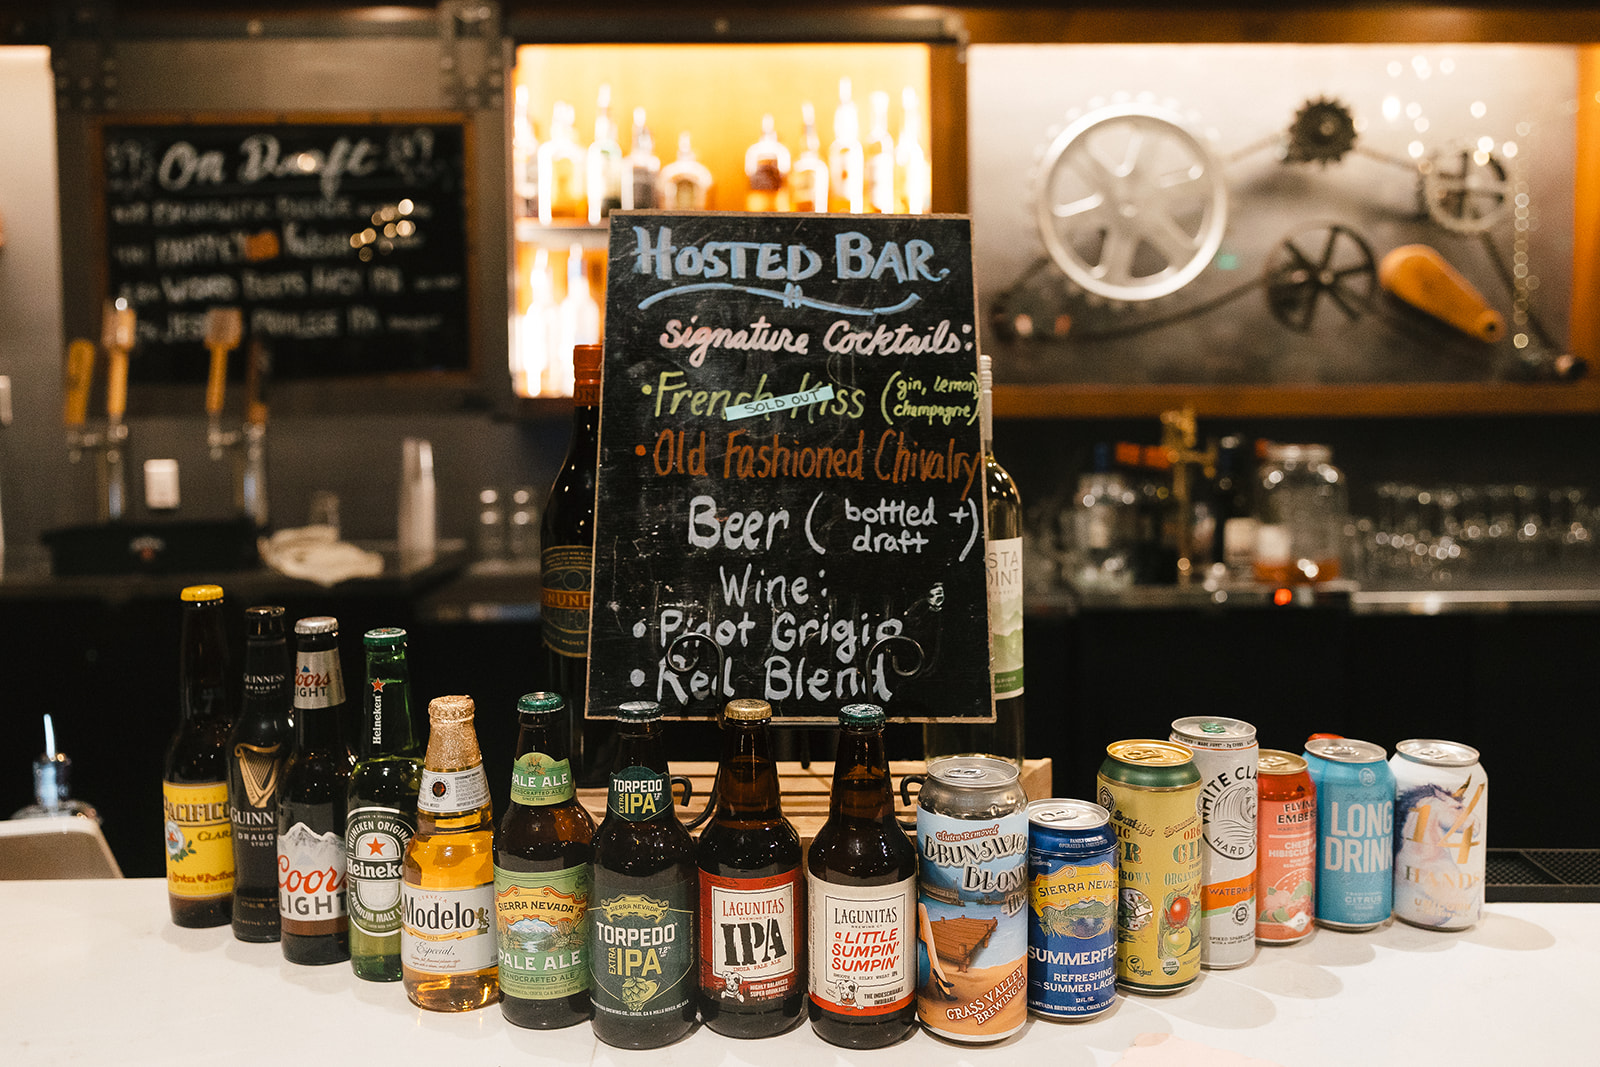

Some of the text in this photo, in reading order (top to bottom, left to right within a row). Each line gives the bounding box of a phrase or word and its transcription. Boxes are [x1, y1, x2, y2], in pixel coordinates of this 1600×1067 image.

[158, 140, 226, 191] On
[632, 225, 950, 284] HOSTED BAR
[659, 315, 973, 368] Signature Cocktails:
[654, 371, 866, 424] French Kiss
[744, 389, 820, 415] SOLD OUT
[653, 427, 981, 502] Old Fashioned Chivalry
[688, 494, 791, 551] Beer
[844, 496, 938, 527] bottled
[851, 523, 930, 555] draft
[718, 562, 828, 608] Wine:
[660, 609, 905, 664] Pinot Grigio
[243, 671, 286, 685] GUINNESS
[655, 652, 893, 706] Red Blend
[294, 685, 328, 699] IGHT
[372, 694, 382, 745] Heineken
[541, 772, 569, 788] ALE
[612, 778, 664, 793] TORPEDO
[618, 792, 657, 815] EXTRA IPA
[1202, 772, 1233, 825] WHITE
[1331, 800, 1393, 838] LONG
[1405, 782, 1486, 865] 14
[348, 820, 375, 849] HEINEKEN
[935, 824, 1000, 843] Gluten Removed
[1212, 836, 1245, 856] HARD
[1118, 842, 1143, 866] R
[1268, 846, 1310, 858] HIBISCUS
[1324, 836, 1393, 874] DRINK
[1038, 881, 1086, 898] SIERRA
[1404, 865, 1481, 890] HANDS
[350, 891, 397, 923] PREMIUM MALT
[402, 892, 475, 930] Modelo
[497, 900, 576, 914] SIERRA NEVADA
[609, 903, 661, 913] SIERRA NEVADA
[722, 897, 785, 917] LAGUNITAS
[1345, 894, 1383, 905] CITRUS
[834, 906, 899, 925] LAGUNITAS
[595, 920, 678, 948] TORPEDO
[720, 917, 787, 967] IPA
[834, 927, 899, 945] a LITTLE
[498, 947, 582, 972] PALE ALE
[608, 946, 617, 976] EXTRA
[616, 947, 663, 977] IPA
[831, 940, 900, 958] SUMPIN'
[754, 963, 769, 971] PALE
[770, 958, 782, 966] ALE
[831, 954, 900, 972] SUMPIN'
[1053, 966, 1112, 983] REFRESHING
[559, 971, 576, 982] ALE
[1043, 981, 1092, 993] SUMMER
[864, 992, 873, 1000] THE
[946, 964, 1023, 1022] GRASS VALLEY
[974, 986, 1019, 1026] BREWING
